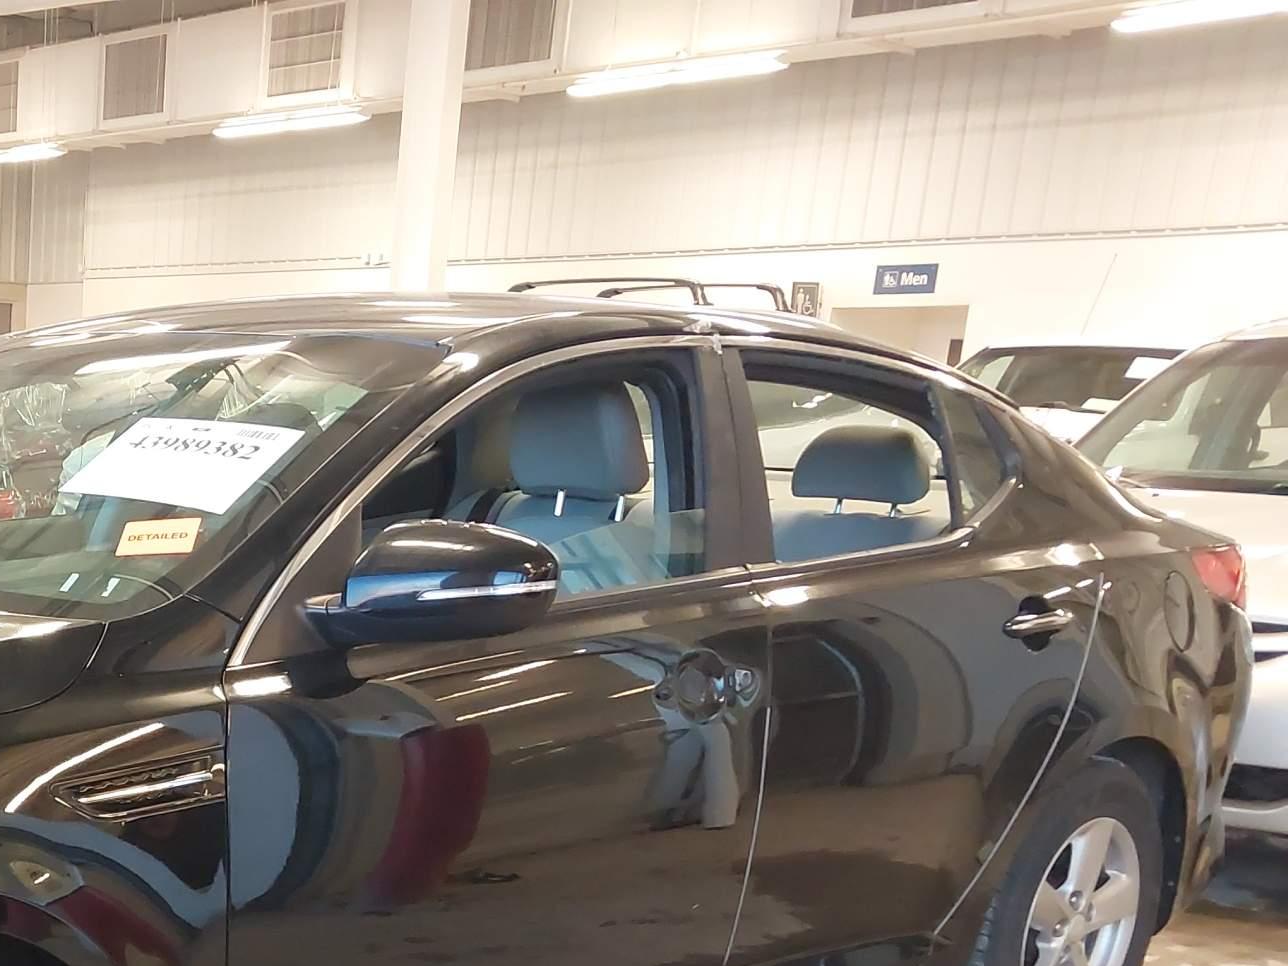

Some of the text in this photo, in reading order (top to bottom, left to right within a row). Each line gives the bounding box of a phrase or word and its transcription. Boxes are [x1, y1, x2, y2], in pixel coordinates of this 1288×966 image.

[900, 271, 928, 286] Men
[129, 434, 261, 460] 43989382
[127, 531, 189, 542] DETAILED
